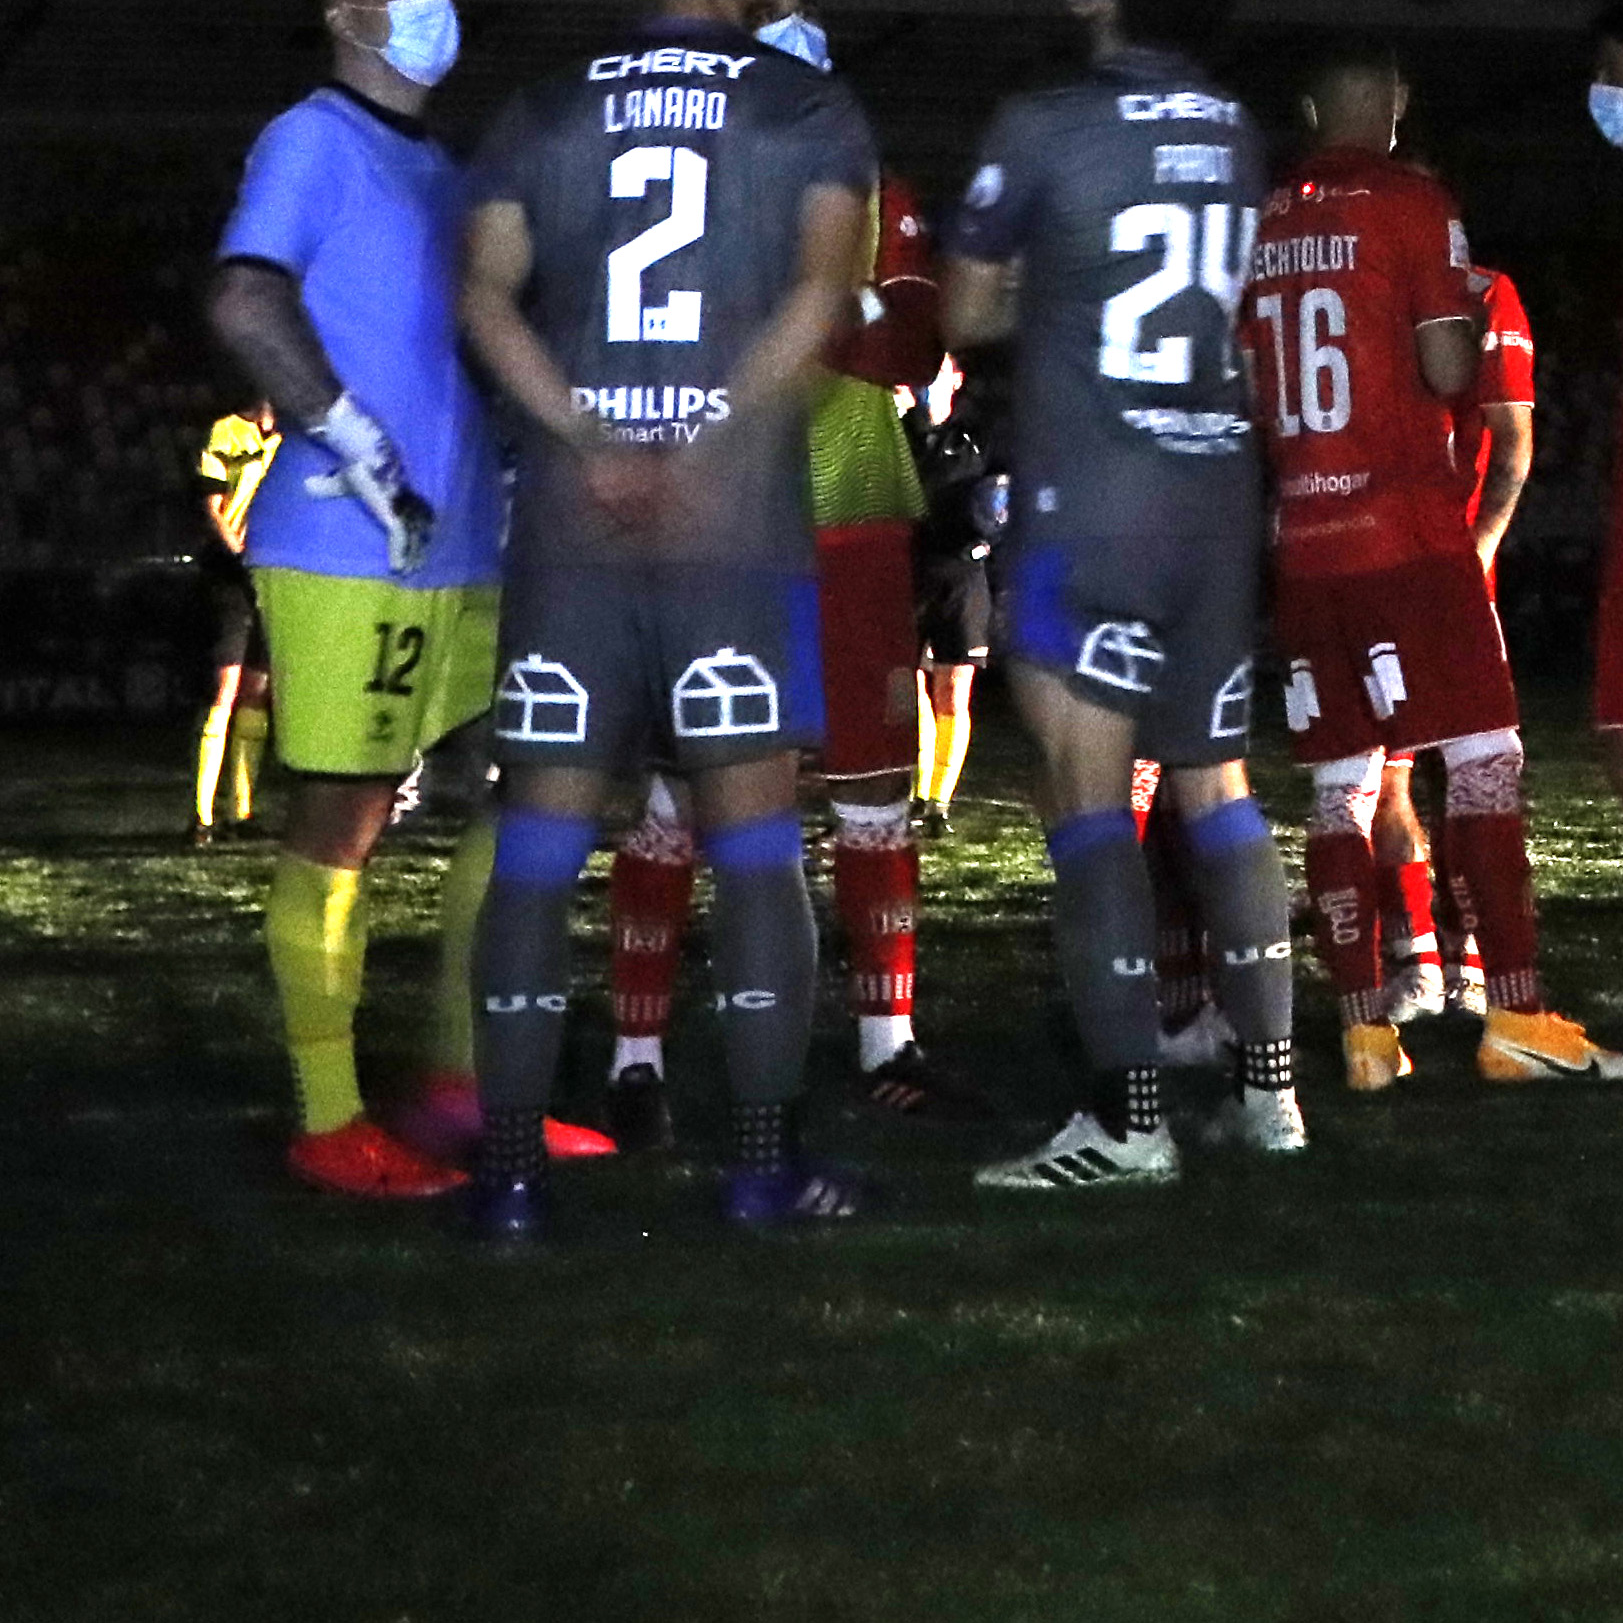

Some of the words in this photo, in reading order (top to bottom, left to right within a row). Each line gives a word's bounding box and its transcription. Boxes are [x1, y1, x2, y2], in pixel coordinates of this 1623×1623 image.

[588, 47, 756, 81] CHERY
[604, 86, 727, 134] LANARO
[607, 146, 708, 342] 2
[1253, 235, 1358, 281] ECHTOLDT
[1099, 203, 1257, 385] 24
[1256, 287, 1353, 438] 16
[570, 385, 731, 421] PHILIPS
[600, 423, 664, 443] Smart
[671, 422, 700, 444] TV
[363, 623, 424, 696] 12
